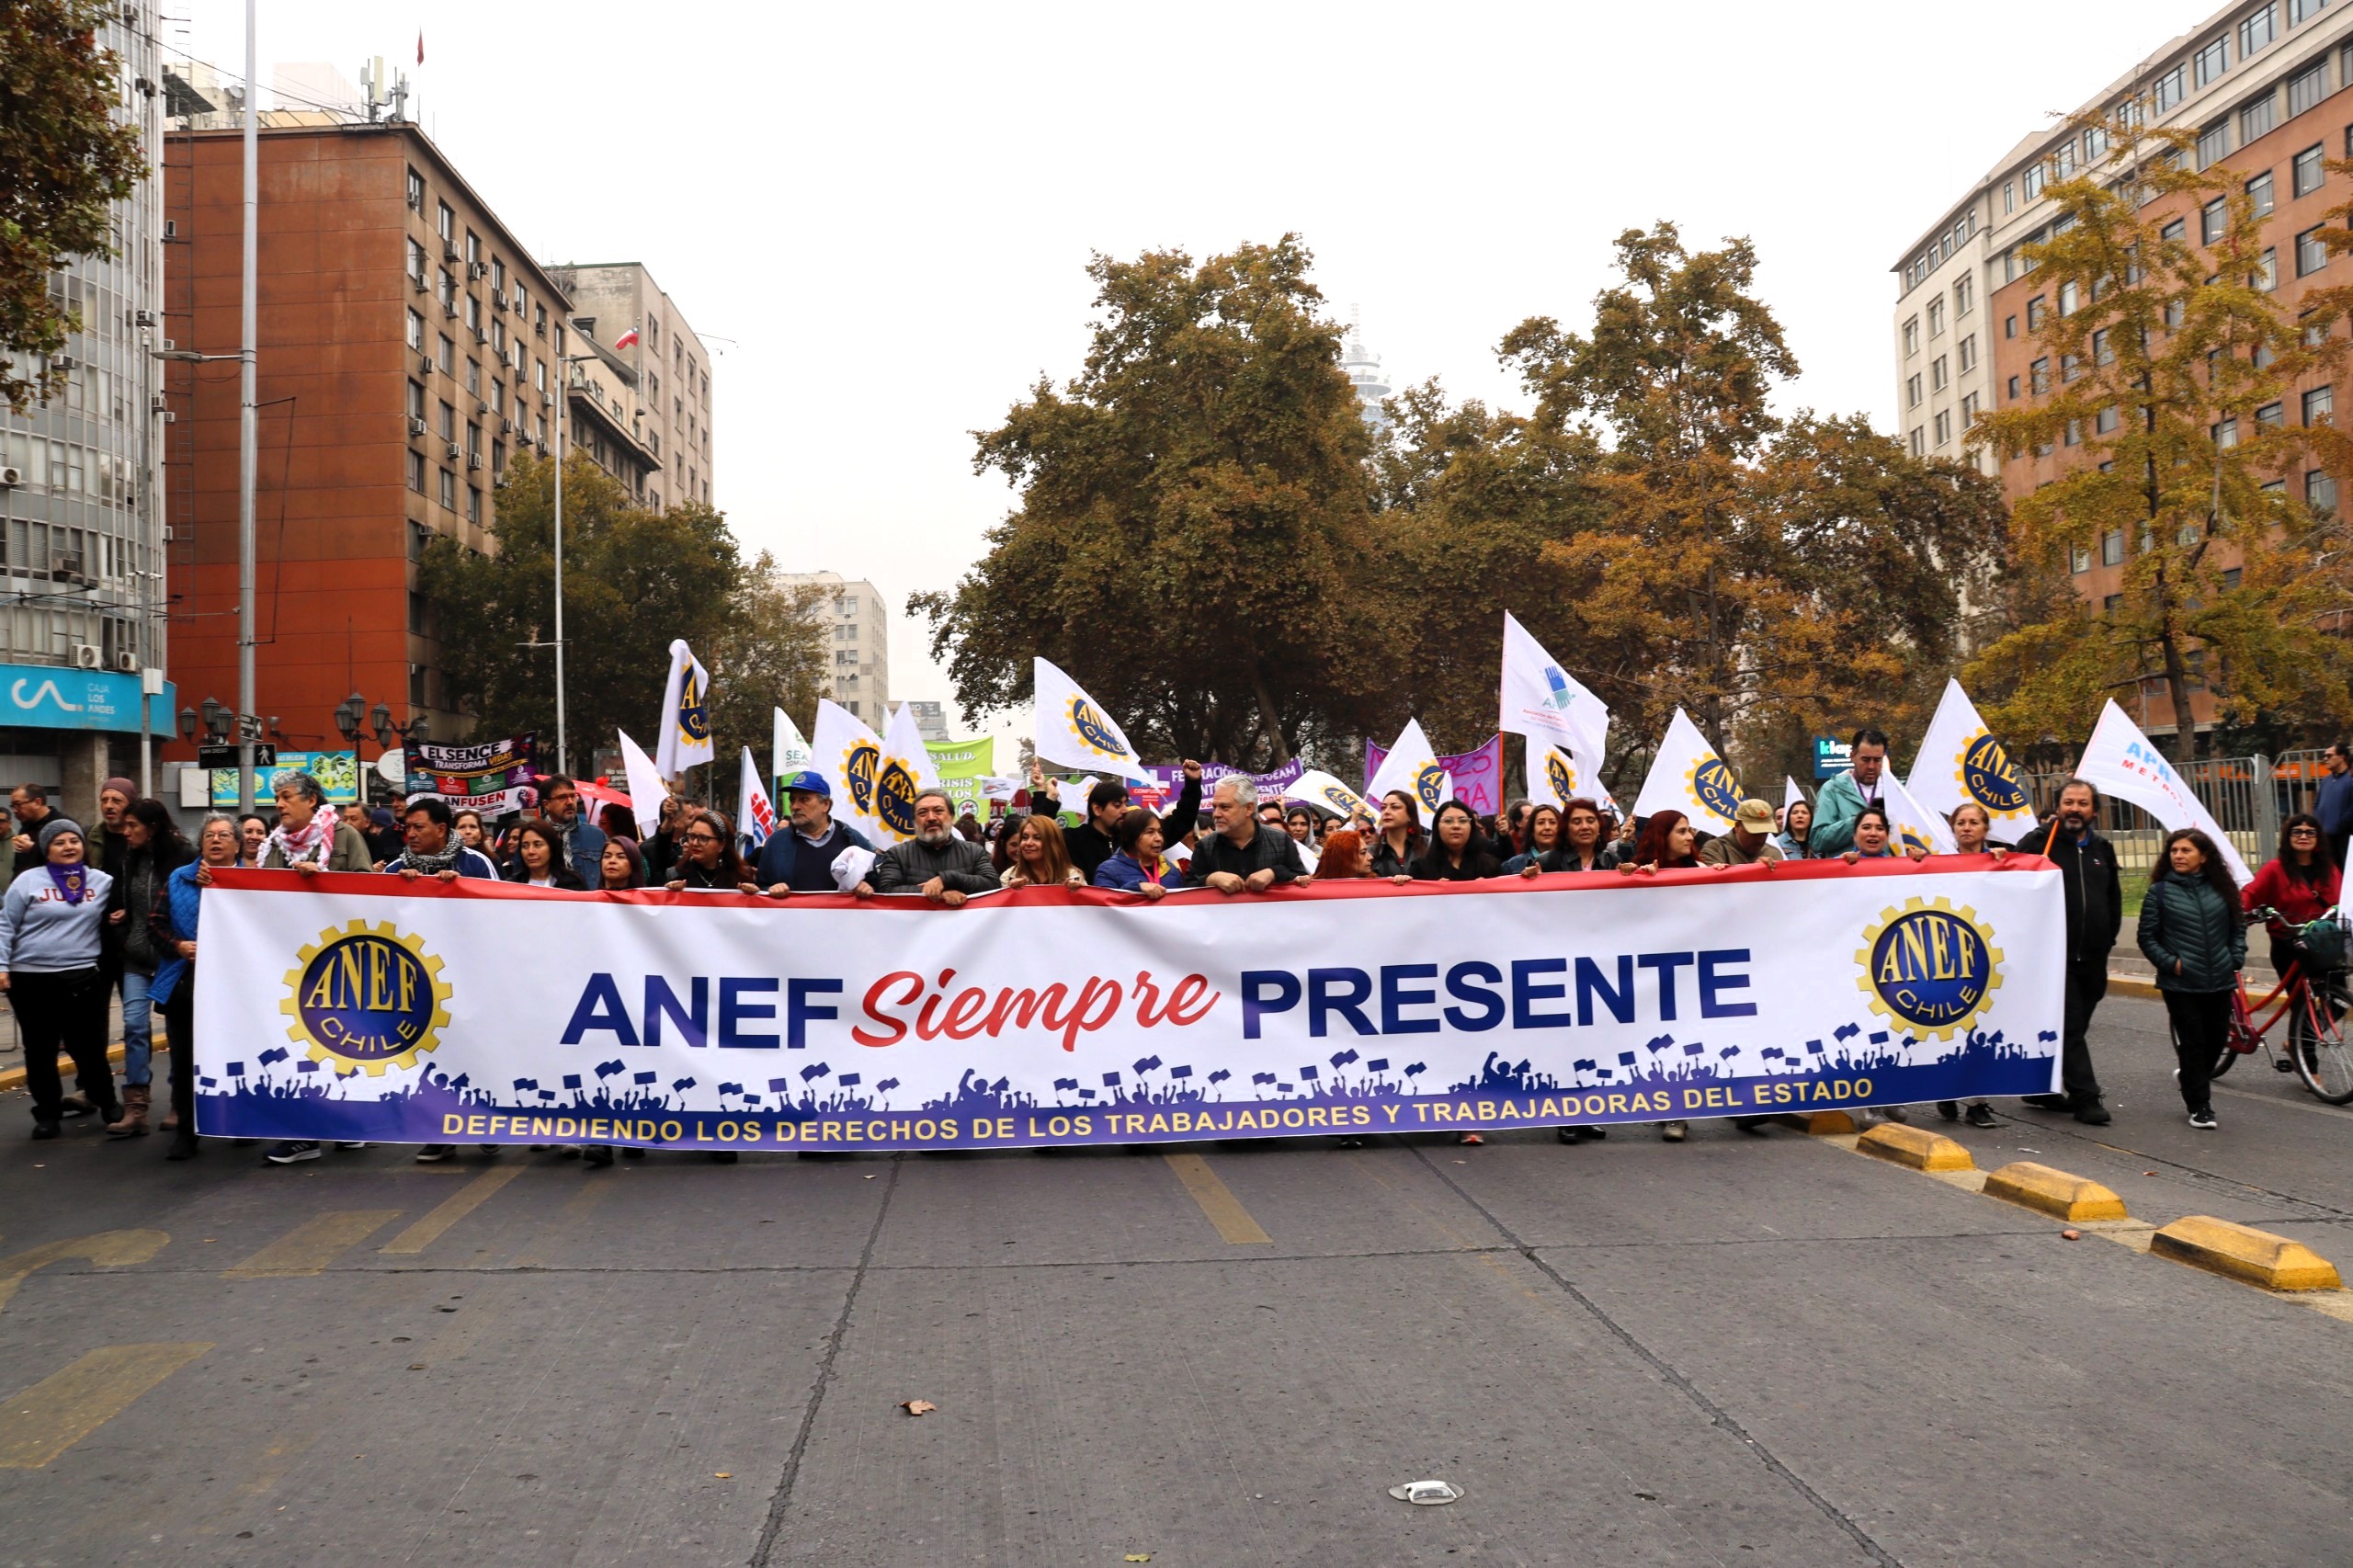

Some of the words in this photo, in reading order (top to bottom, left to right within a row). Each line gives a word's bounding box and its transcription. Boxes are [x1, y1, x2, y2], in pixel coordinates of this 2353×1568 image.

[87, 683, 110, 693] CAJA
[87, 694, 105, 703] LOS
[87, 704, 116, 714] ANDES
[427, 746, 443, 760] EL
[446, 743, 501, 761] SENCE
[435, 760, 487, 770] TRANSFORMA
[488, 752, 513, 765] VIDAS
[939, 778, 973, 788] RISIS
[1699, 765, 1745, 803] ANE
[1972, 773, 2024, 806] CHILE
[882, 795, 915, 830] CHIL
[40, 888, 96, 903] JUP
[1879, 915, 1976, 984] ANEF
[305, 939, 418, 1012] ANEF
[559, 971, 844, 1050] ANEF
[851, 968, 1222, 1052] Siempre
[1241, 948, 1758, 1040] PRESENTE
[1895, 985, 1978, 1019] CHILE
[320, 1016, 418, 1053] CHILE
[443, 1113, 683, 1142] DEFENDIENDO
[697, 1120, 762, 1142] LOS
[776, 1119, 959, 1142] DERECHOS
[972, 1117, 1016, 1140] DE
[1029, 1115, 1093, 1138] LOS
[1105, 1104, 1371, 1135] TRABAJADORES
[1382, 1104, 1403, 1124] Y
[1413, 1090, 1672, 1123] TRABAJADORAS
[1684, 1086, 1744, 1110] DEL
[1754, 1077, 1874, 1105] ESTADO
